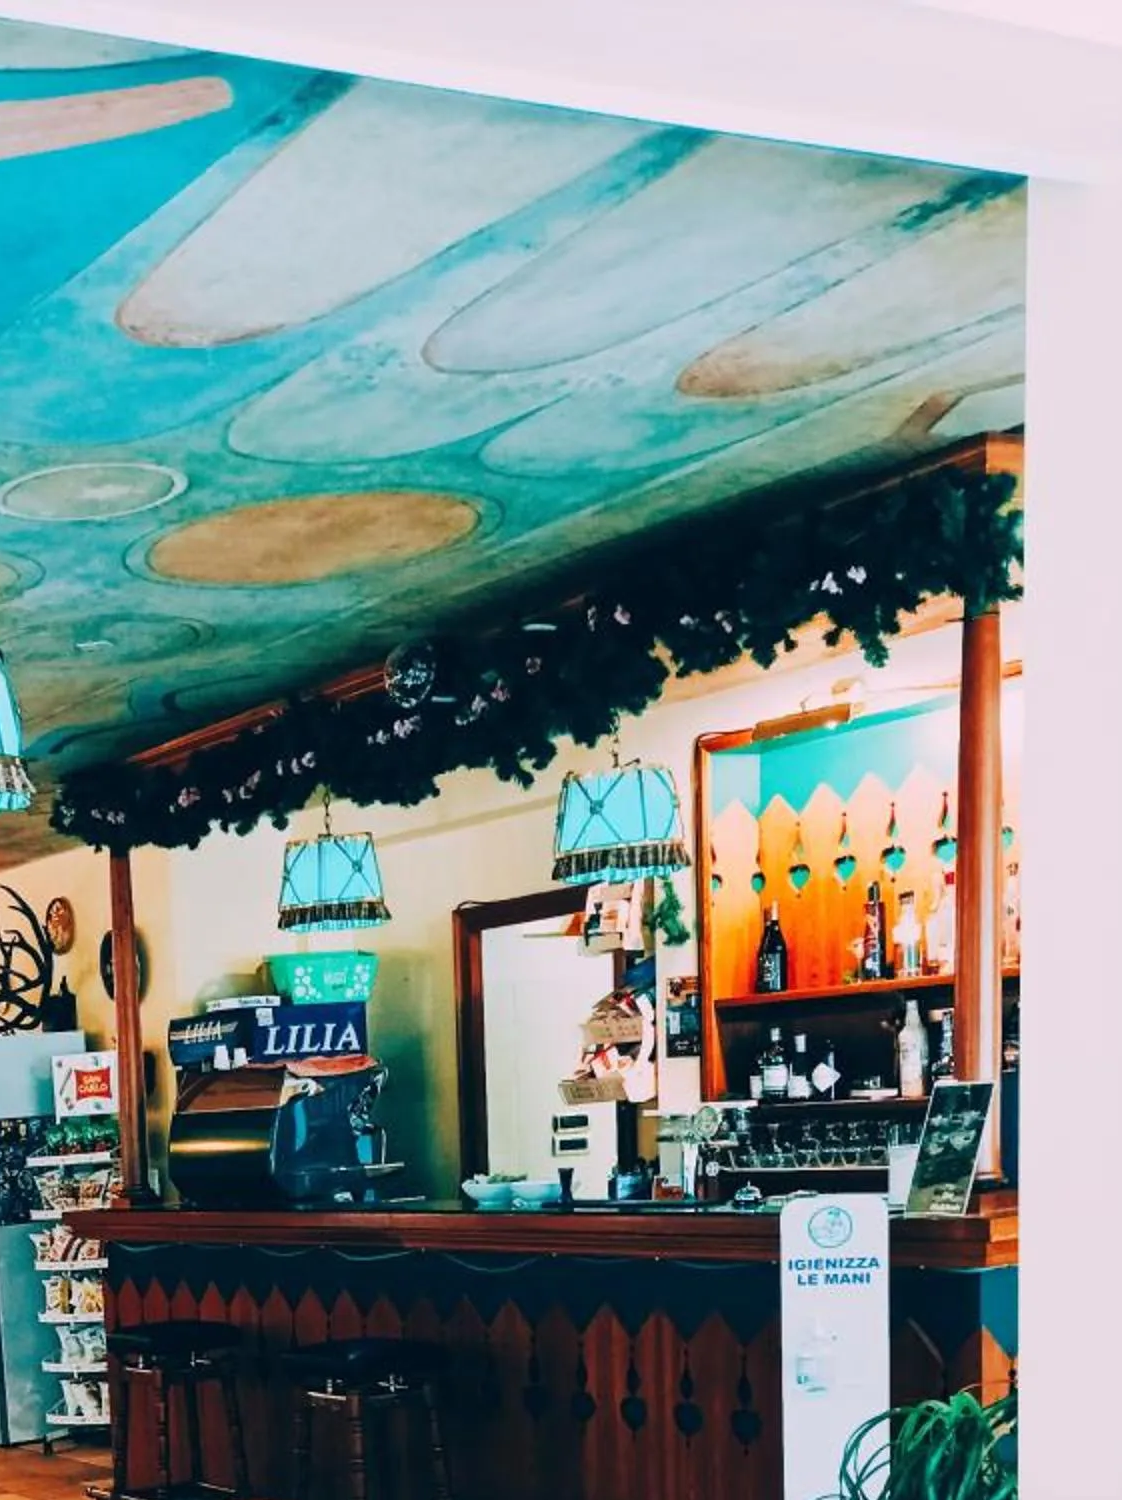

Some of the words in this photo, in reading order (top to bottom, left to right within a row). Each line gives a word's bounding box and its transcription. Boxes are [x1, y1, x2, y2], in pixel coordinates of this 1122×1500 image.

[183, 1019, 223, 1045] LILIA
[263, 1021, 361, 1056] LILIA
[788, 1257, 880, 1271] IGIENIZZA
[797, 1273, 819, 1286] LE
[824, 1272, 872, 1285] MANI
